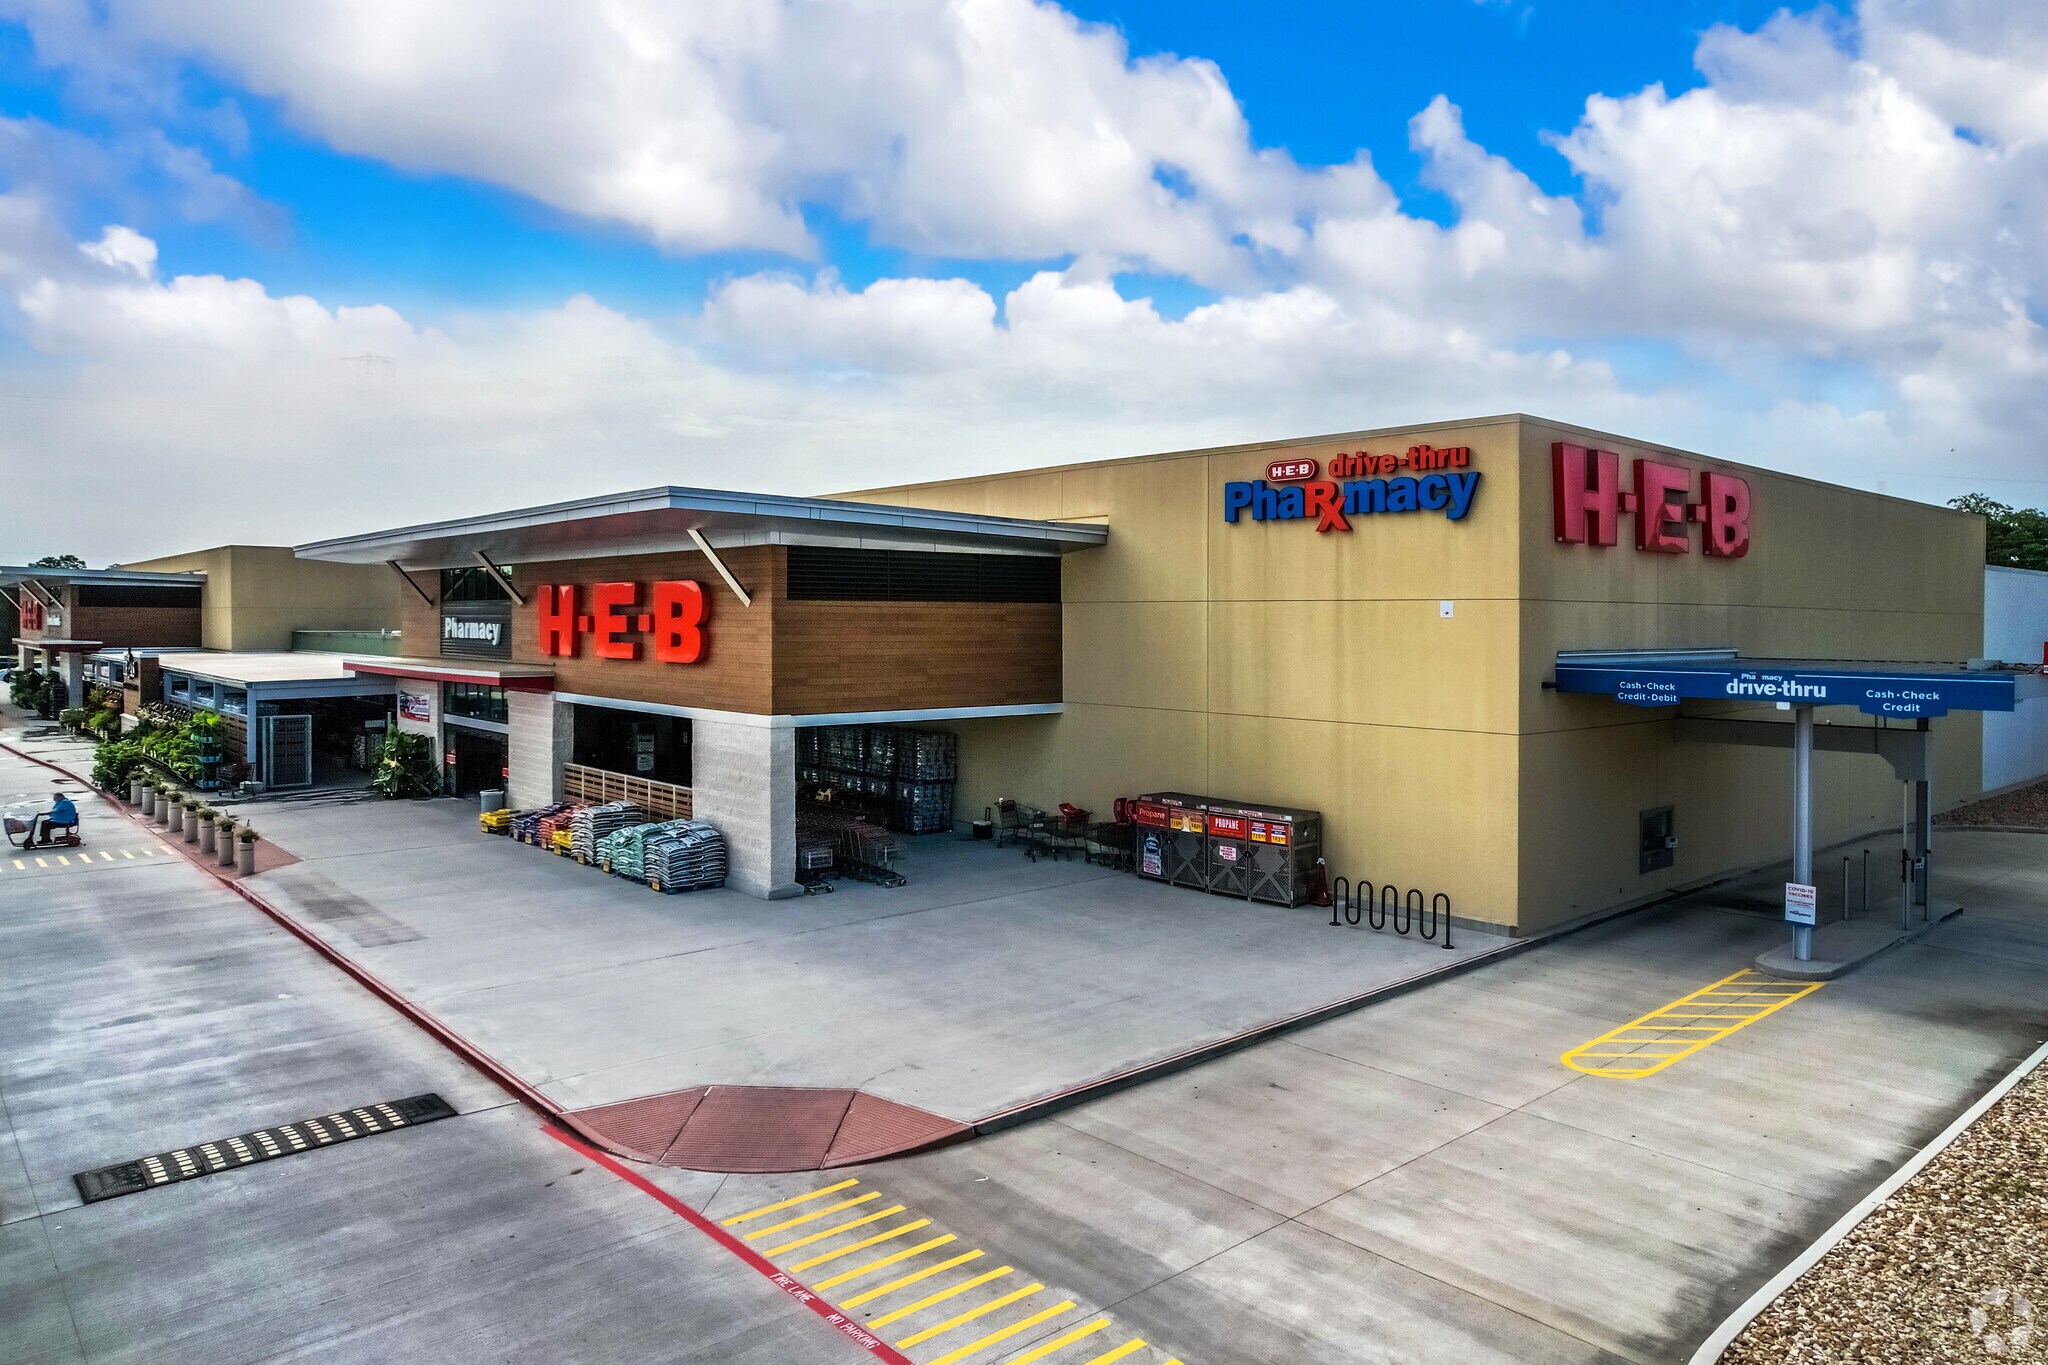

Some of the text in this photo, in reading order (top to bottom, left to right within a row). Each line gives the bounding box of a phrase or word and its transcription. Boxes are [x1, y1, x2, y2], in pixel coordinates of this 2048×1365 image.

[1329, 445, 1470, 478] drive-thru
[444, 617, 502, 646] Pharmacy
[1741, 673, 1783, 682] Phamacy
[1726, 678, 1827, 698] drive-thru
[1882, 702, 1921, 712] Credit
[1139, 808, 1166, 820] Propane
[1215, 817, 1239, 830] PROPANE
[1788, 886, 1814, 894] COVID-19
[1788, 891, 1814, 899] VACCINES
[770, 1272, 815, 1303] FIRE LANE
[826, 1313, 880, 1349] NO PARKING
